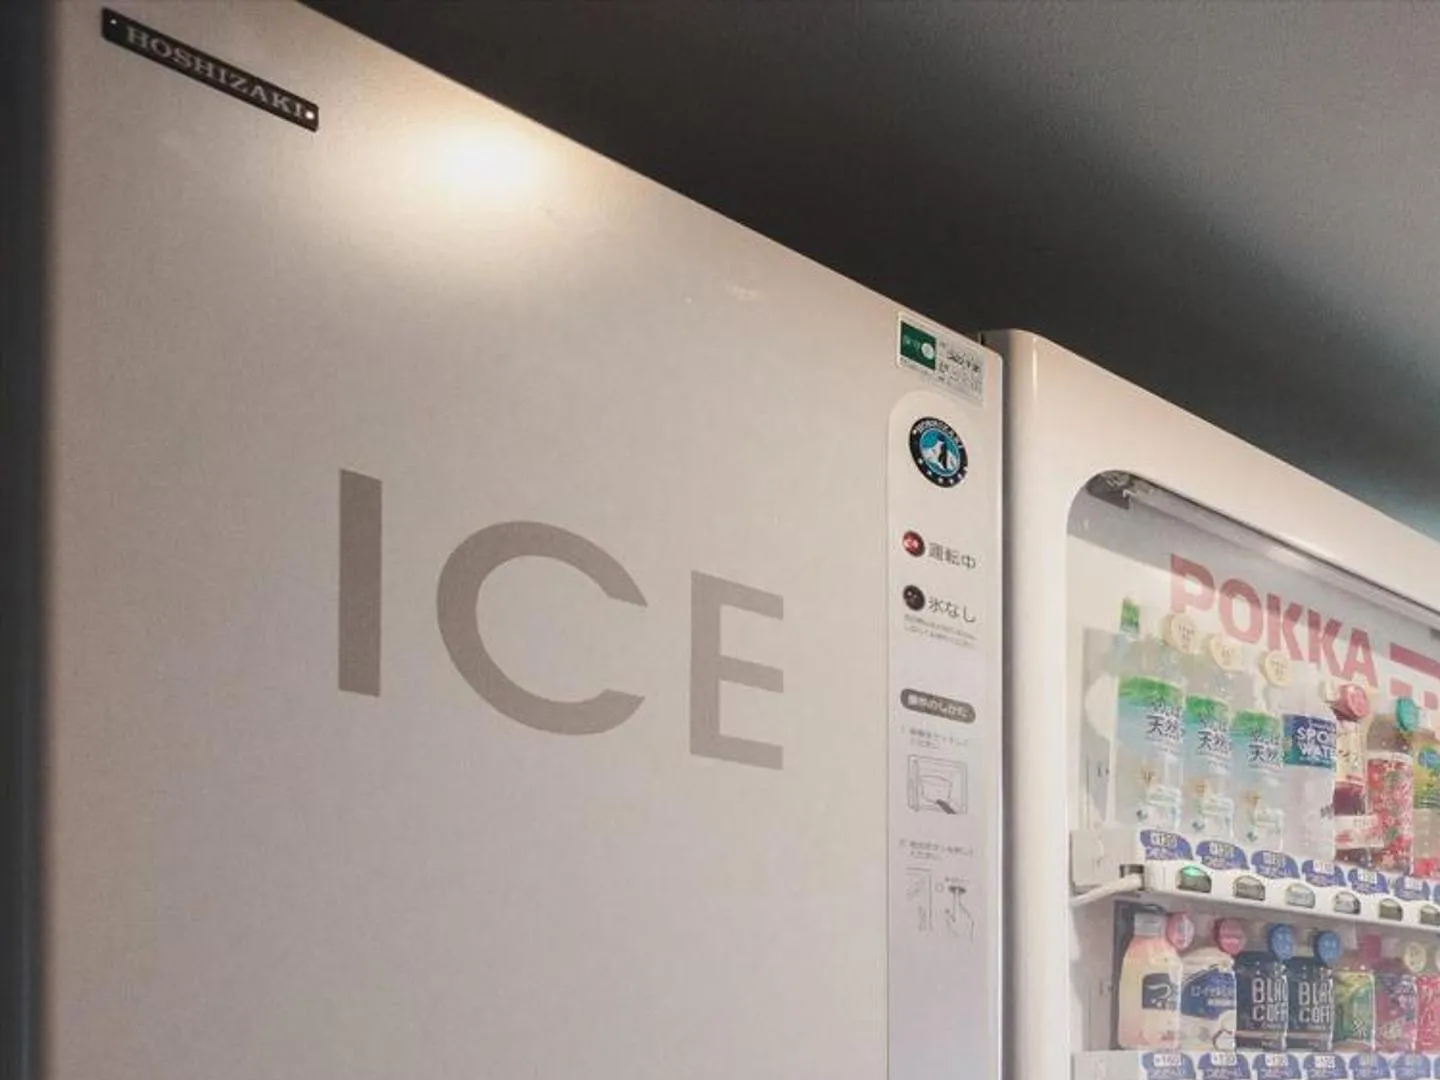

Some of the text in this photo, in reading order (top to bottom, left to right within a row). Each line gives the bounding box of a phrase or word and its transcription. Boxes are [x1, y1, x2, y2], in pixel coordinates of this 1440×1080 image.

[125, 25, 305, 121] HOSHIZAKI
[928, 542, 977, 569] 運転中
[338, 468, 783, 770] ICE
[928, 596, 977, 623] 氷なし
[1170, 552, 1379, 689] POKKA
[1296, 726, 1333, 744] SPO
